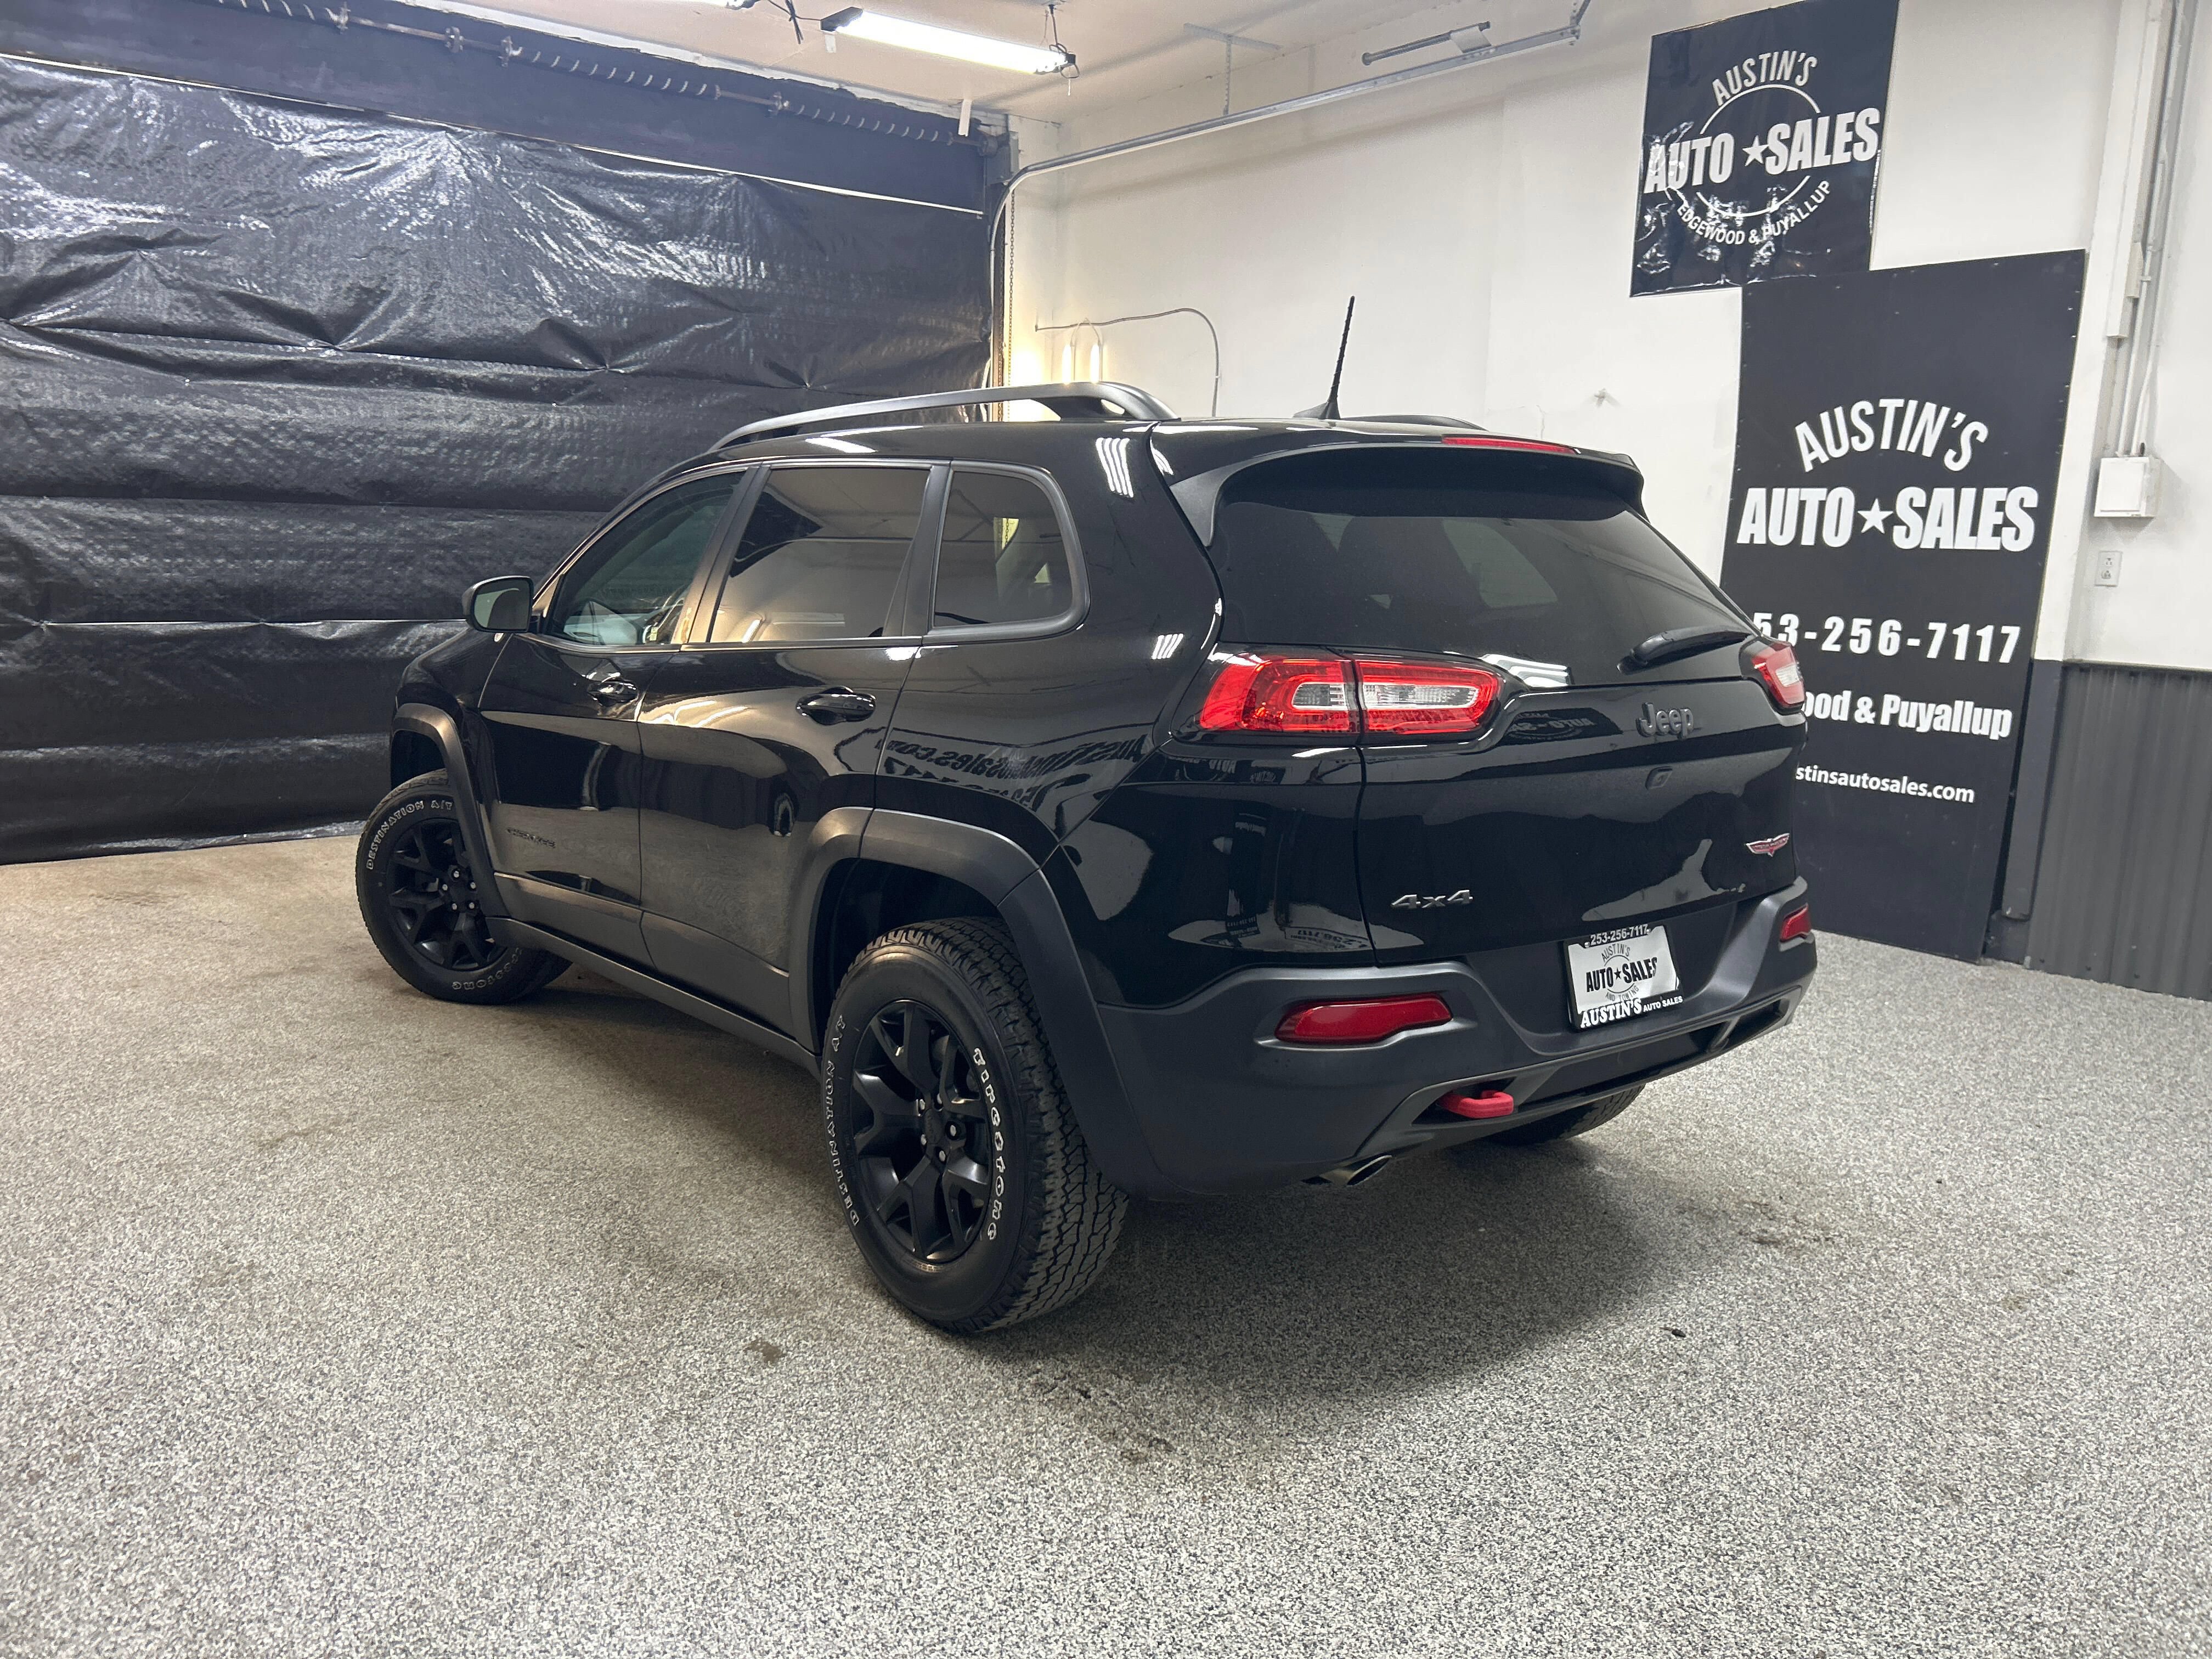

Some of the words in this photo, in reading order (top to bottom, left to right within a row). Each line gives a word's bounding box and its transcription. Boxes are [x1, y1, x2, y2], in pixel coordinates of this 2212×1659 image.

[1712, 50, 1817, 105] AUSTIN'S
[1643, 133, 1735, 194] AUTO
[1764, 108, 1881, 175] SALES
[1677, 205, 1746, 245] EDGEWOOD
[1748, 229, 1759, 244] &
[1762, 180, 1831, 240] PUYALLUP
[1795, 398, 1989, 472] AUSTIN'S
[1736, 486, 1855, 548] AUTO
[1893, 486, 2039, 552] SALES
[1753, 612, 2021, 664] 53-256-7117
[1636, 702, 1694, 740] Jeep
[1854, 695, 1876, 724] &
[1880, 693, 2013, 741] Puyallup
[1795, 764, 1975, 803] stinsautosales.com
[366, 800, 425, 870] DESTINATION
[431, 799, 453, 810] A/T
[1391, 889, 1474, 909] 4x4
[1590, 924, 1648, 946] 253-256-7117
[1601, 943, 1630, 962] AUSTIN'S
[1586, 967, 1614, 992] AUTO
[1622, 957, 1657, 983] SALES
[1605, 991, 1616, 1001] AND
[1618, 985, 1639, 1001] TOWING
[1580, 997, 1642, 1028] AUSTIN'S
[1643, 1002, 1661, 1012] AUTO
[1662, 995, 1683, 1007] SALES
[825, 1059, 860, 1227] DESTINATION
